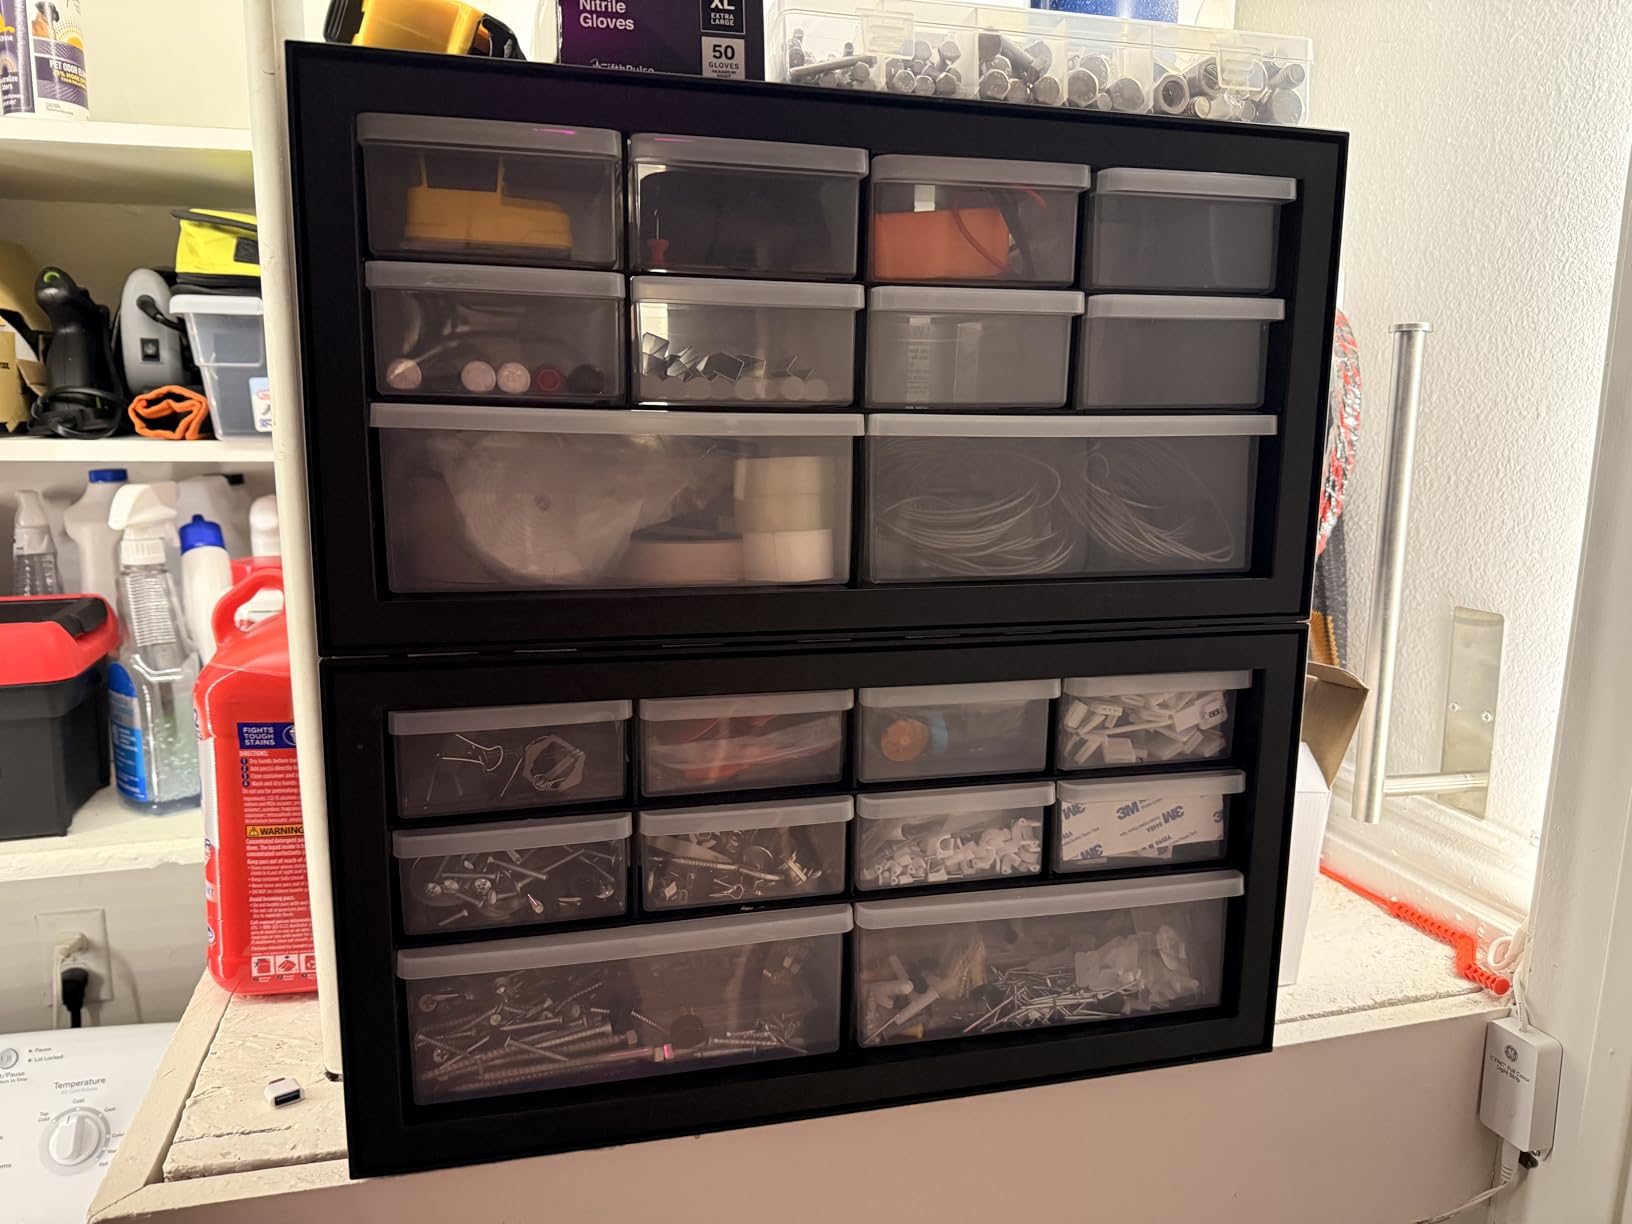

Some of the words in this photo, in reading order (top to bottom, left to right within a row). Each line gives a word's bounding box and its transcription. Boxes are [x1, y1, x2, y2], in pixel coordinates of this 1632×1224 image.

[579, 0, 626, 13] Nitrile
[710, 0, 736, 10] XL
[710, 12, 734, 20] EXTRA
[579, 13, 635, 31] Gloves
[710, 18, 735, 26] LARGE
[712, 44, 735, 60] 50
[708, 61, 740, 70] GLOVES
[242, 726, 274, 734] FIGHTS
[1116, 800, 1140, 820] 3M
[1161, 805, 1184, 824] 3M
[259, 826, 304, 836] WARNING
[54, 1077, 107, 1090] Temperature
